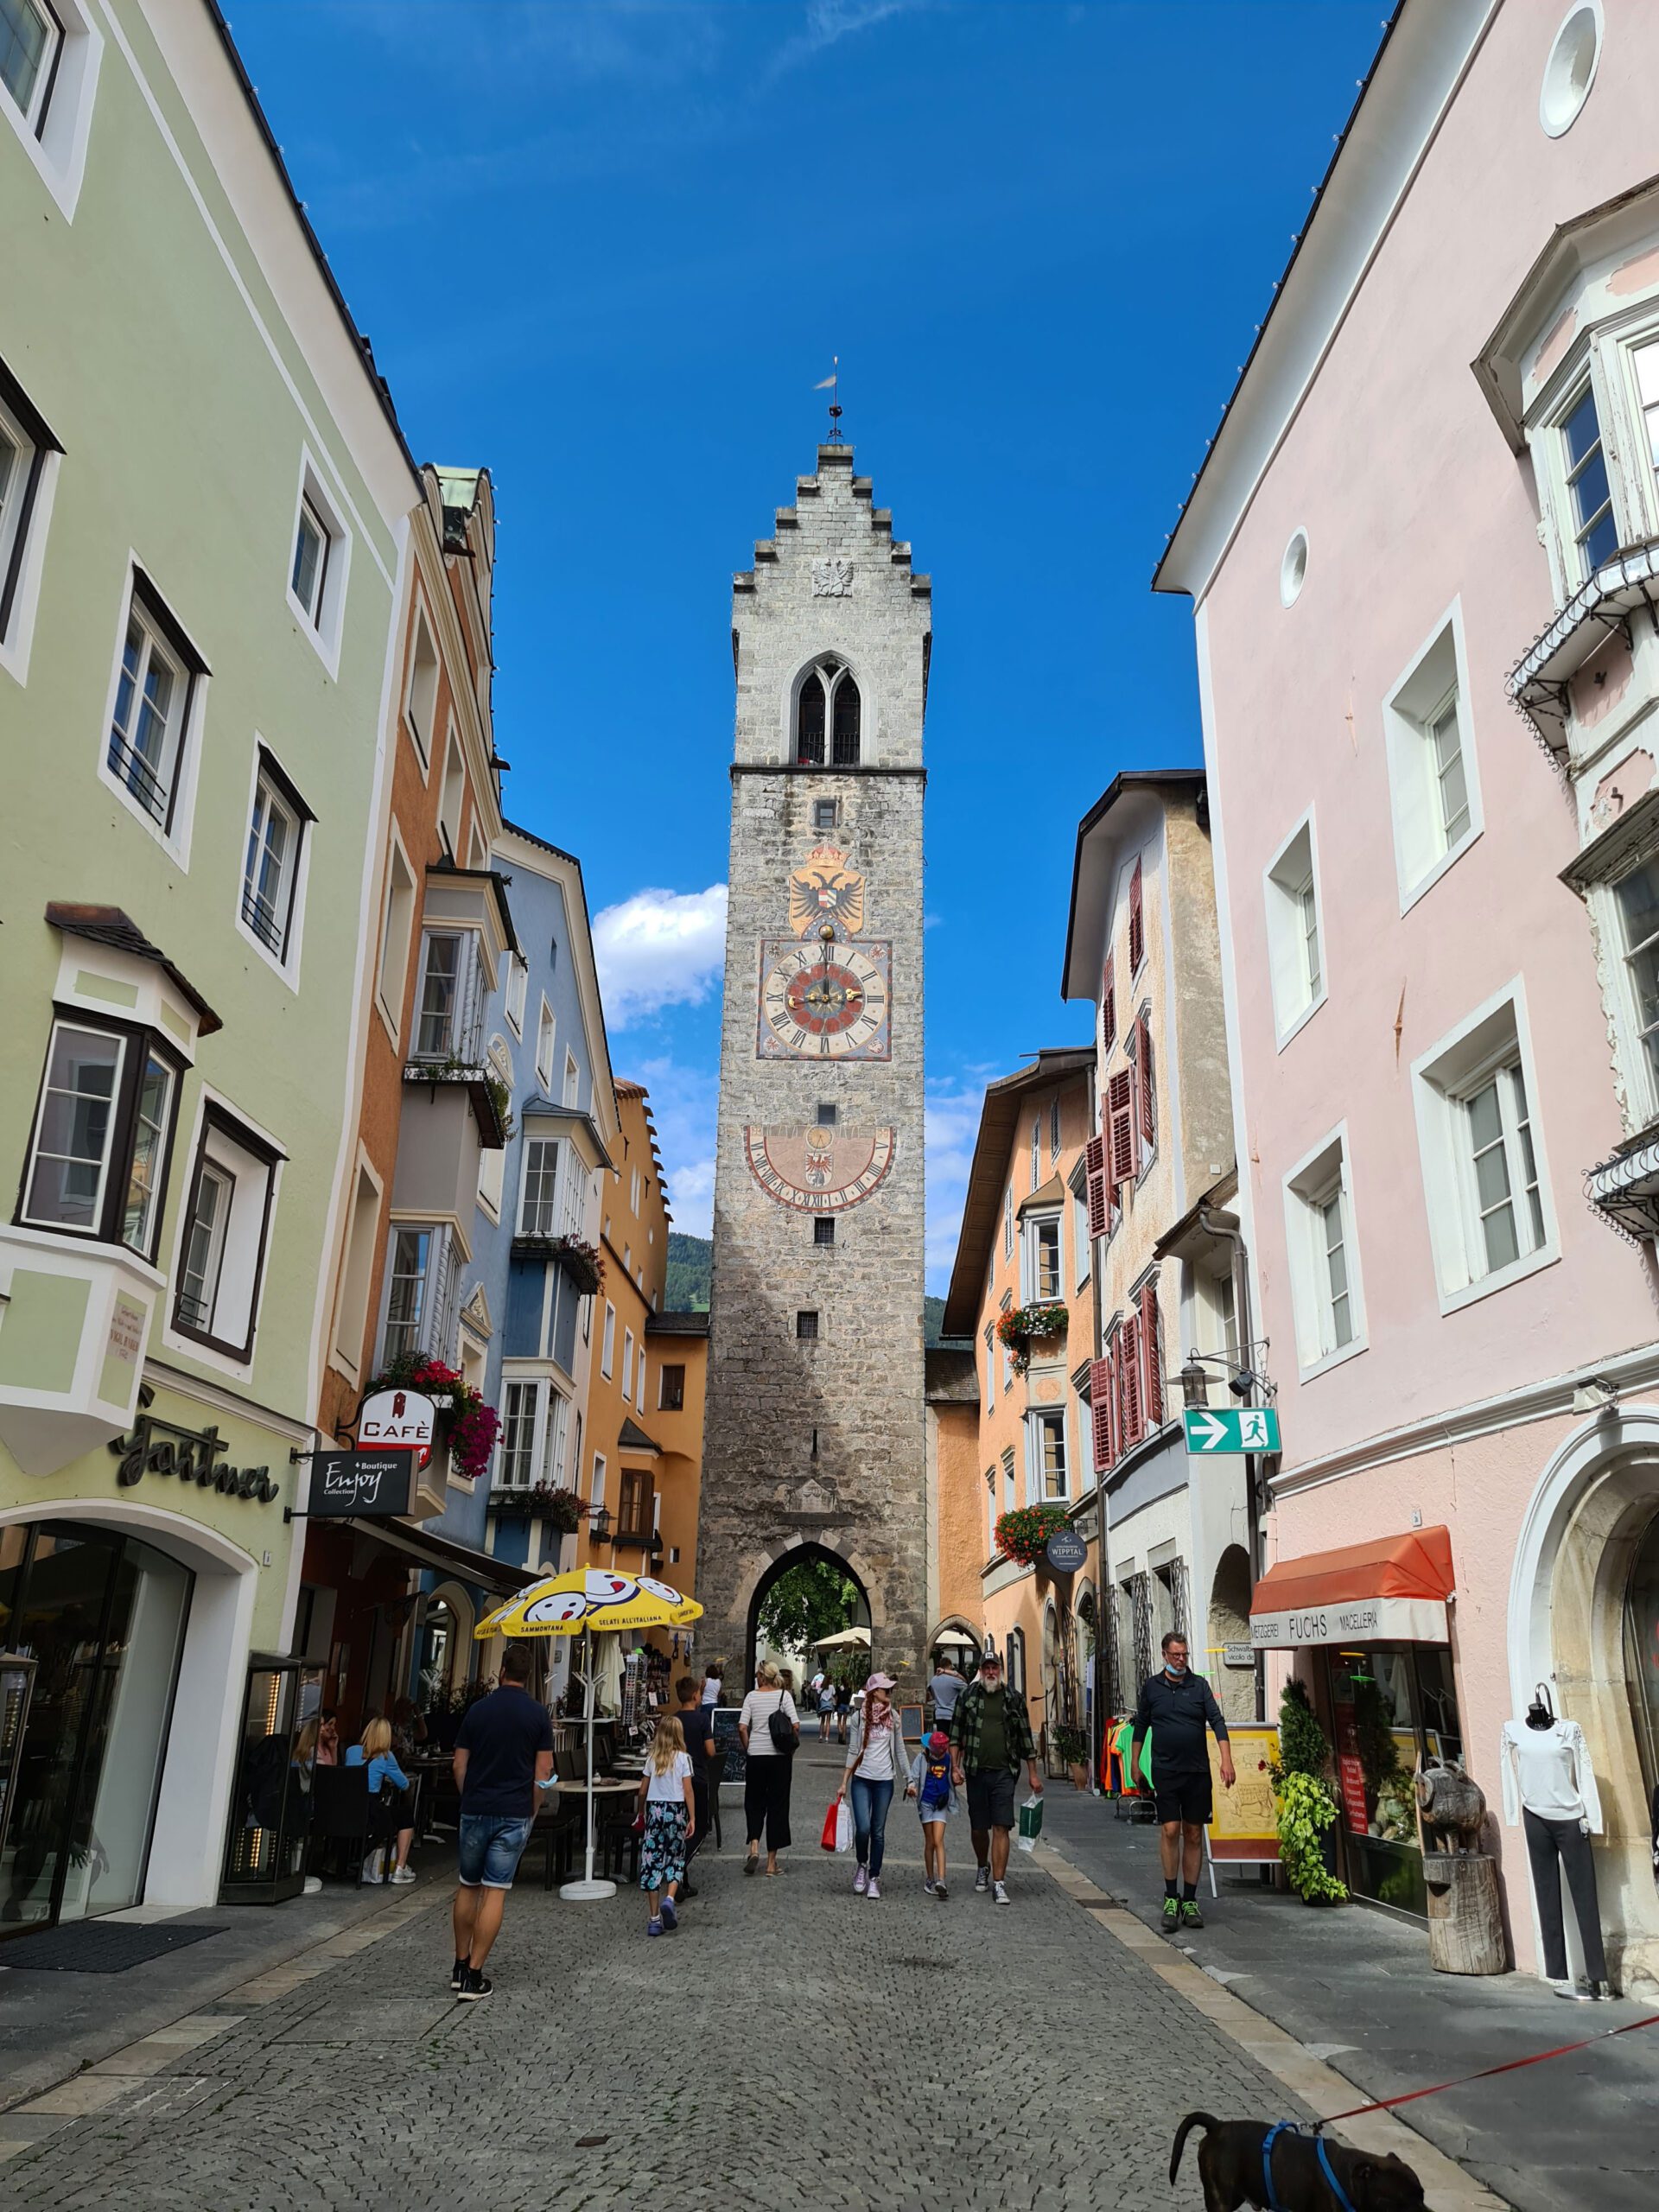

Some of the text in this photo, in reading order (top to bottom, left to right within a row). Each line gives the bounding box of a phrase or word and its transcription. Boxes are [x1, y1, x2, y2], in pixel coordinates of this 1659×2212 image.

[364, 1421, 429, 1439] CAFÈ
[361, 1462, 397, 1471] Boutique
[325, 1461, 382, 1507] Enjoy
[622, 1615, 662, 1624] ALL'ITALIANA
[1289, 1614, 1327, 1639] FUCHS
[1339, 1611, 1378, 1631] MACELLERIA
